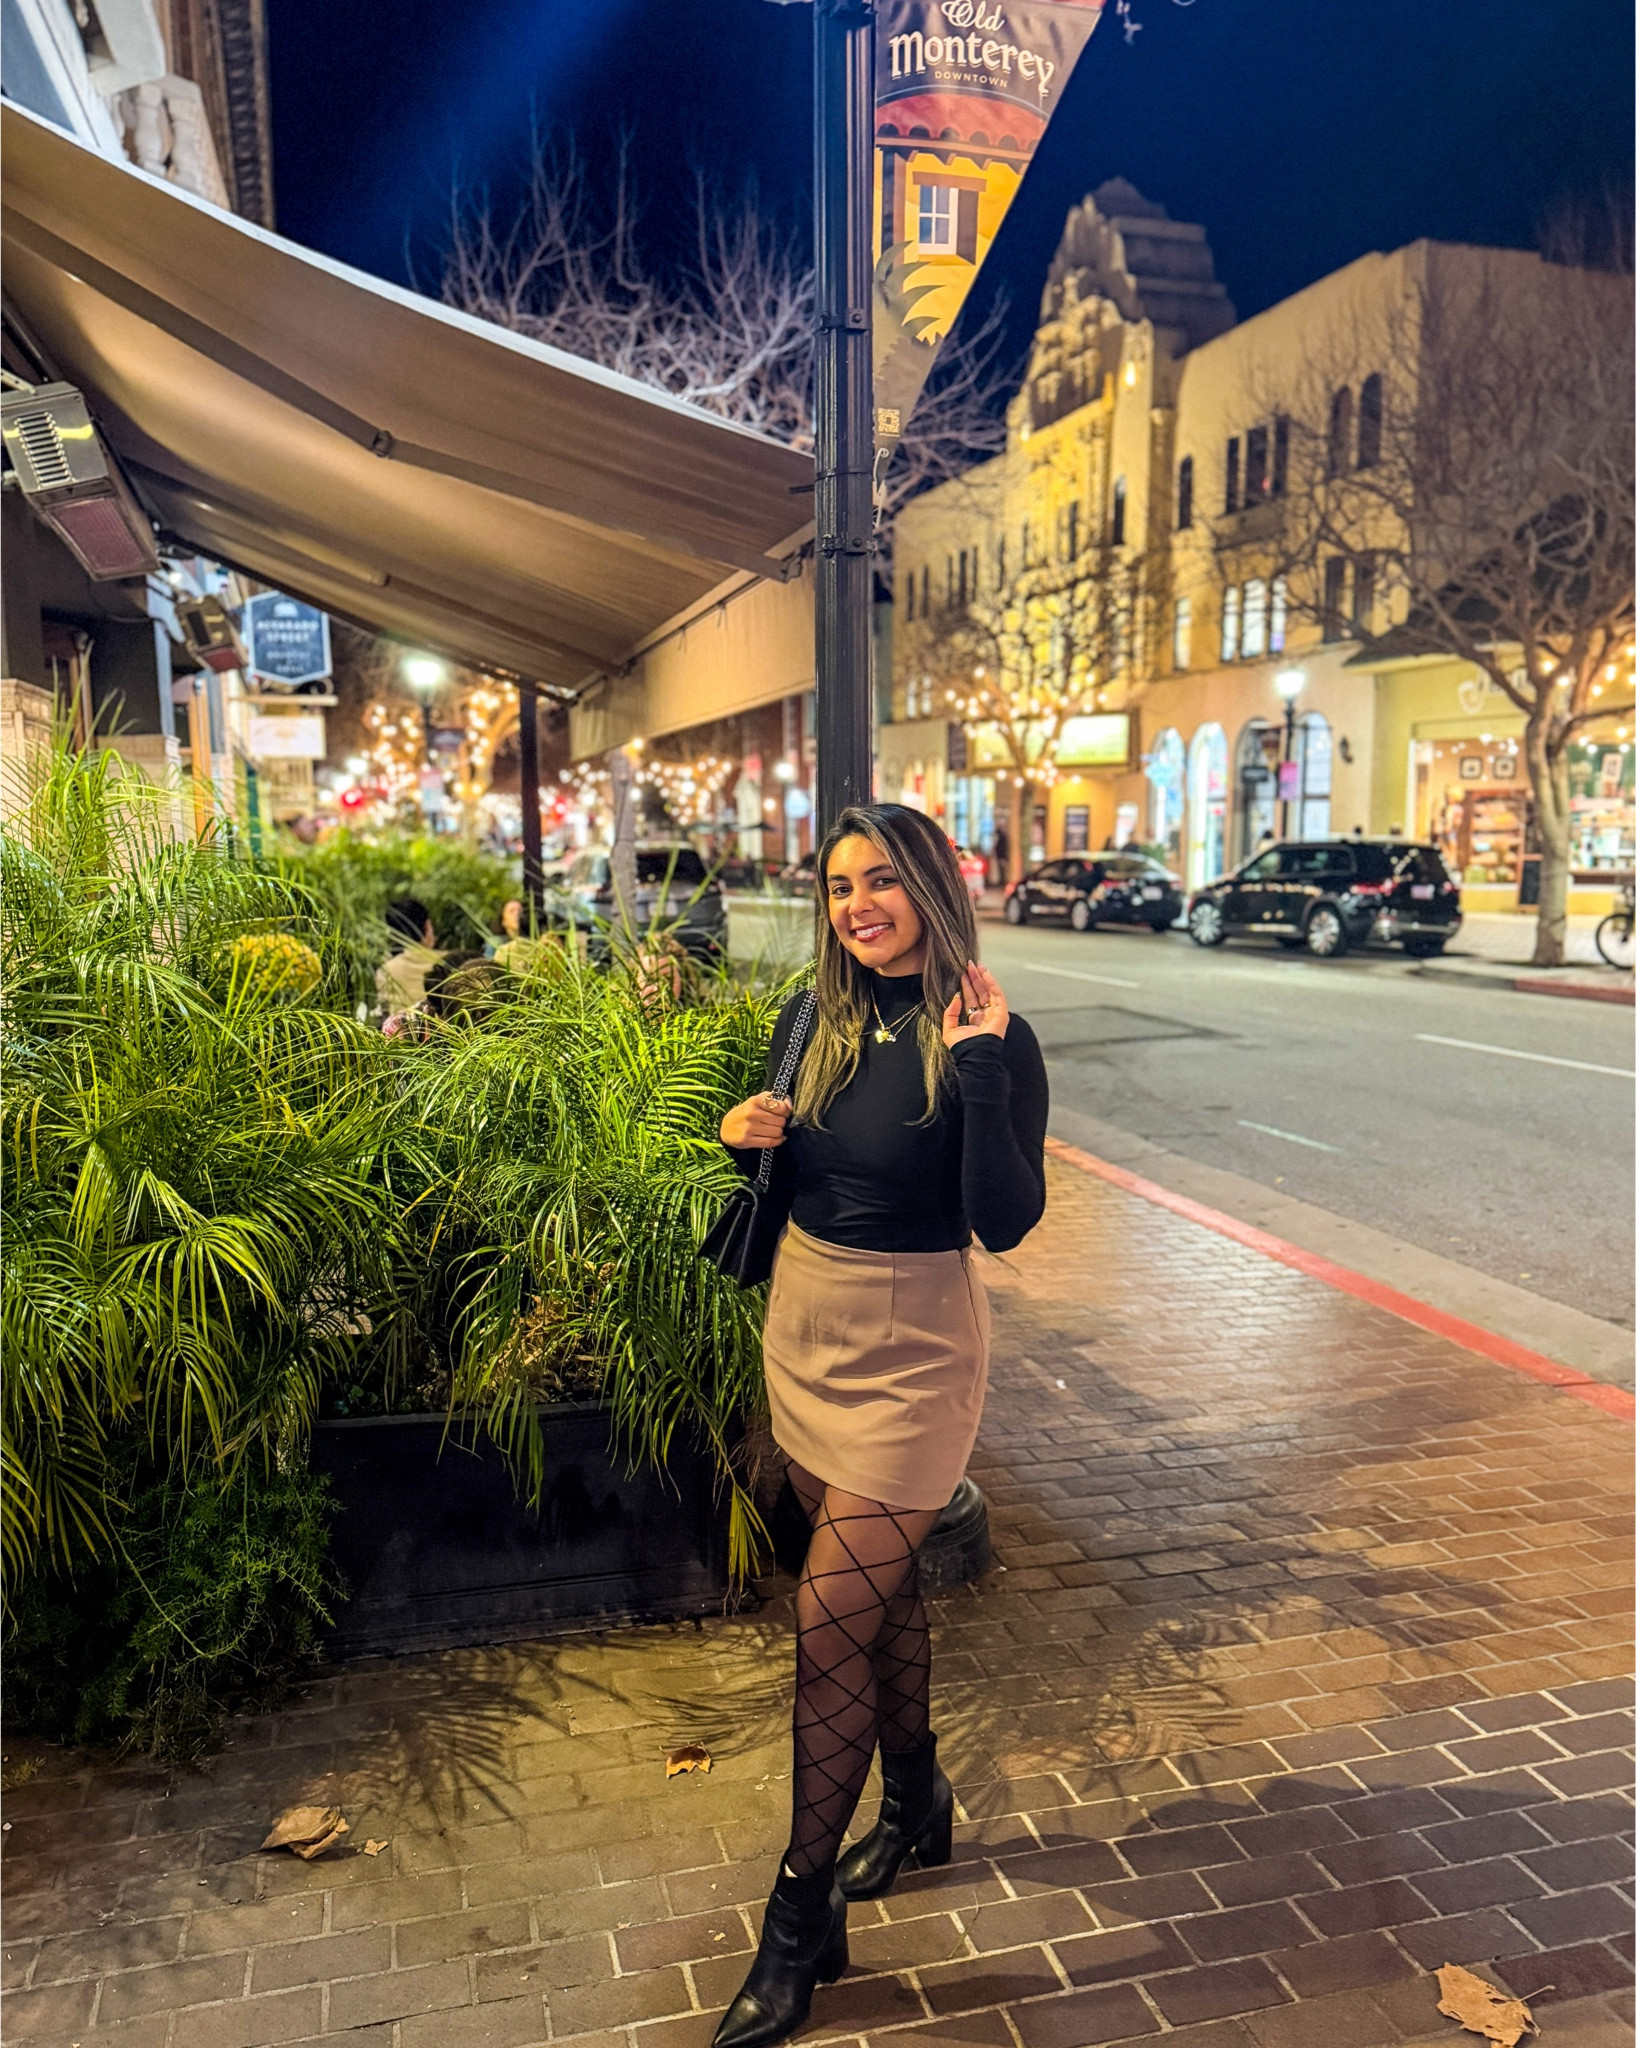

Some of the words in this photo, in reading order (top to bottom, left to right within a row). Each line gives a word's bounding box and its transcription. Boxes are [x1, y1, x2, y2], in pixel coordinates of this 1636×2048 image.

[941, 0, 1005, 31] Old
[888, 31, 1055, 97] Monterey
[934, 71, 1008, 88] DOWNTOWN
